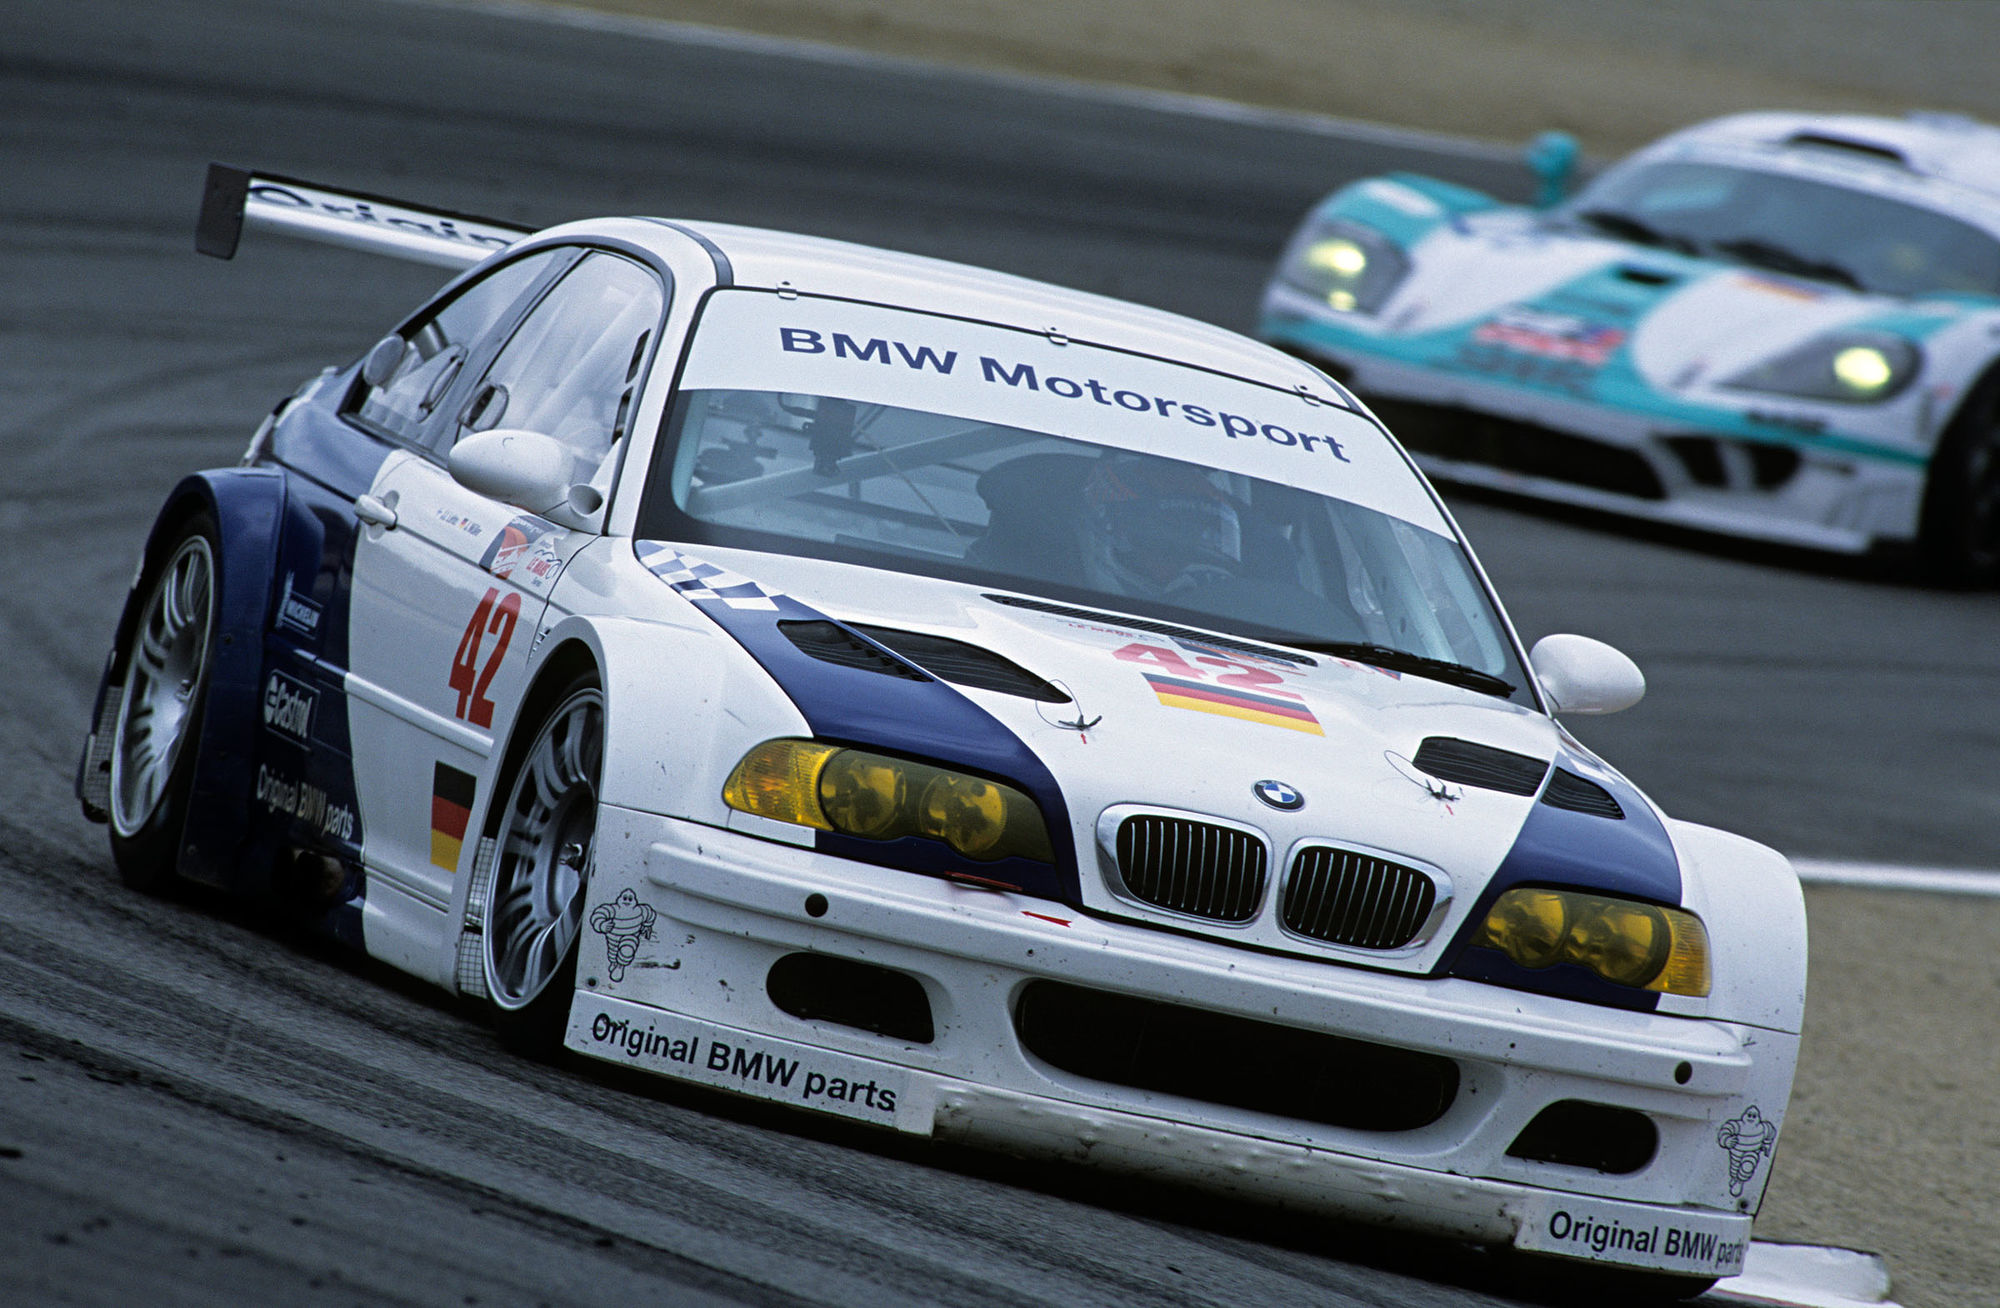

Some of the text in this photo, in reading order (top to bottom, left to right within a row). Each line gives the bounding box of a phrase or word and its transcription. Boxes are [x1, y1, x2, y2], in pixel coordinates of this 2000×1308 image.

[779, 327, 1351, 463] BMW Motorsport
[448, 586, 522, 730] 42
[1111, 642, 1305, 701] 42
[274, 682, 313, 738] Castrol
[256, 763, 354, 841] Original BMW parts
[592, 1012, 897, 1112] Original BMW parts
[1549, 1211, 1659, 1253] Original
[1664, 1228, 1718, 1262] BMW
